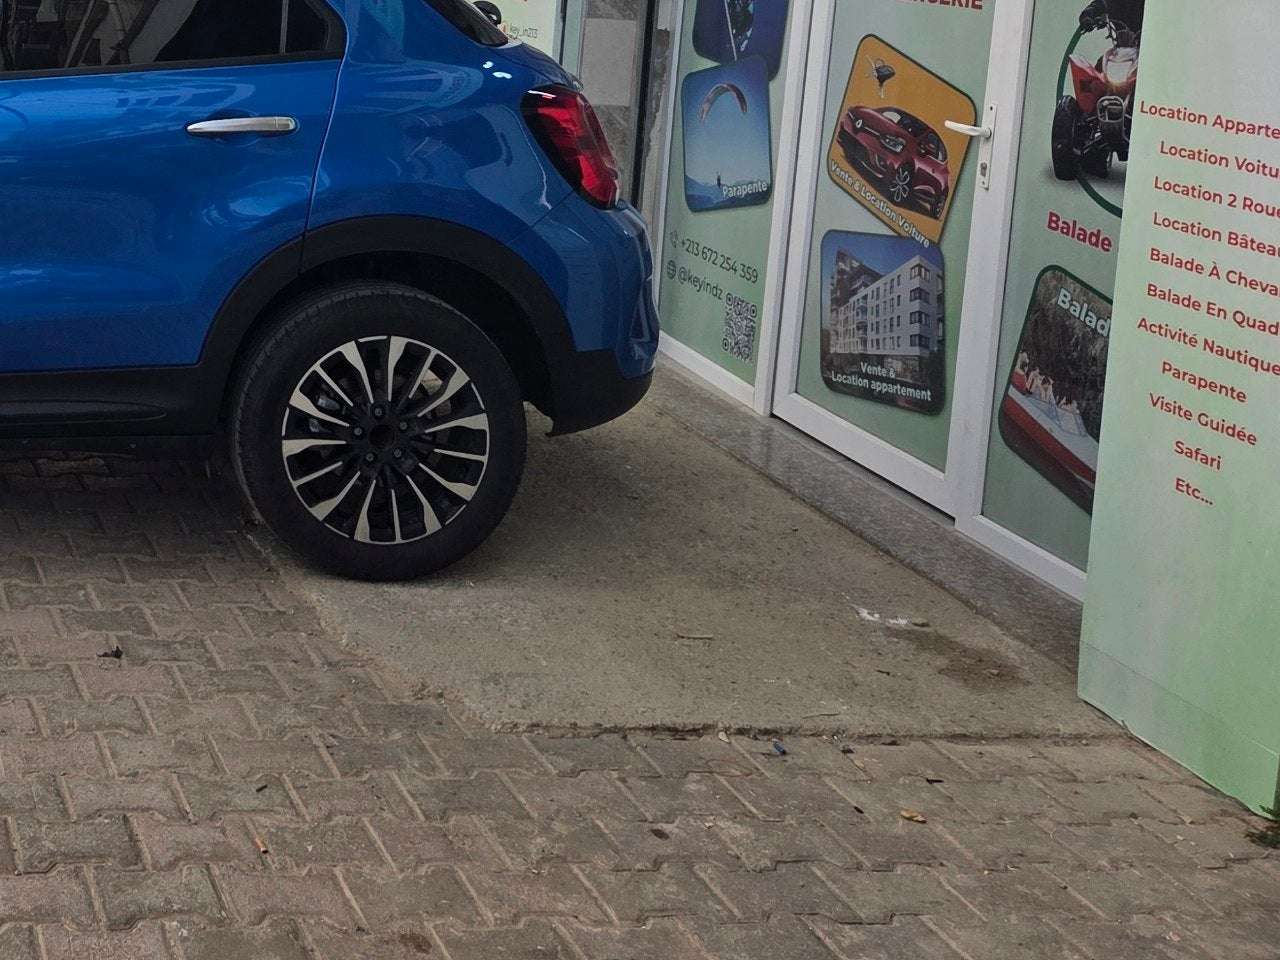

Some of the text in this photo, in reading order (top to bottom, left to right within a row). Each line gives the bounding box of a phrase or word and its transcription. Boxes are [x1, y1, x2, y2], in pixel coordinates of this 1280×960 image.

[1140, 100, 1208, 125] Location
[1160, 140, 1280, 179] Location Voitu
[722, 180, 768, 199] Parapente
[831, 161, 853, 187] Vente
[861, 185, 896, 222] Location
[1154, 176, 1223, 204] Location
[1227, 193, 1237, 208] 2
[1047, 211, 1112, 252] Balade
[1153, 212, 1280, 257] Location Bâtea
[681, 238, 758, 284] +213 672 254 359
[1150, 248, 1280, 297] Balade À Cheva
[678, 267, 723, 300] @keyindz
[1147, 283, 1279, 337] Balade En Quad
[1137, 317, 1280, 376] Activité Nautique
[831, 371, 932, 401] Location appartement
[861, 362, 896, 378] Vente &
[1162, 361, 1247, 403] Parapente
[1149, 392, 1257, 446] Visite Guidée
[1174, 440, 1221, 470] Safari
[1175, 477, 1214, 505] Etc...
